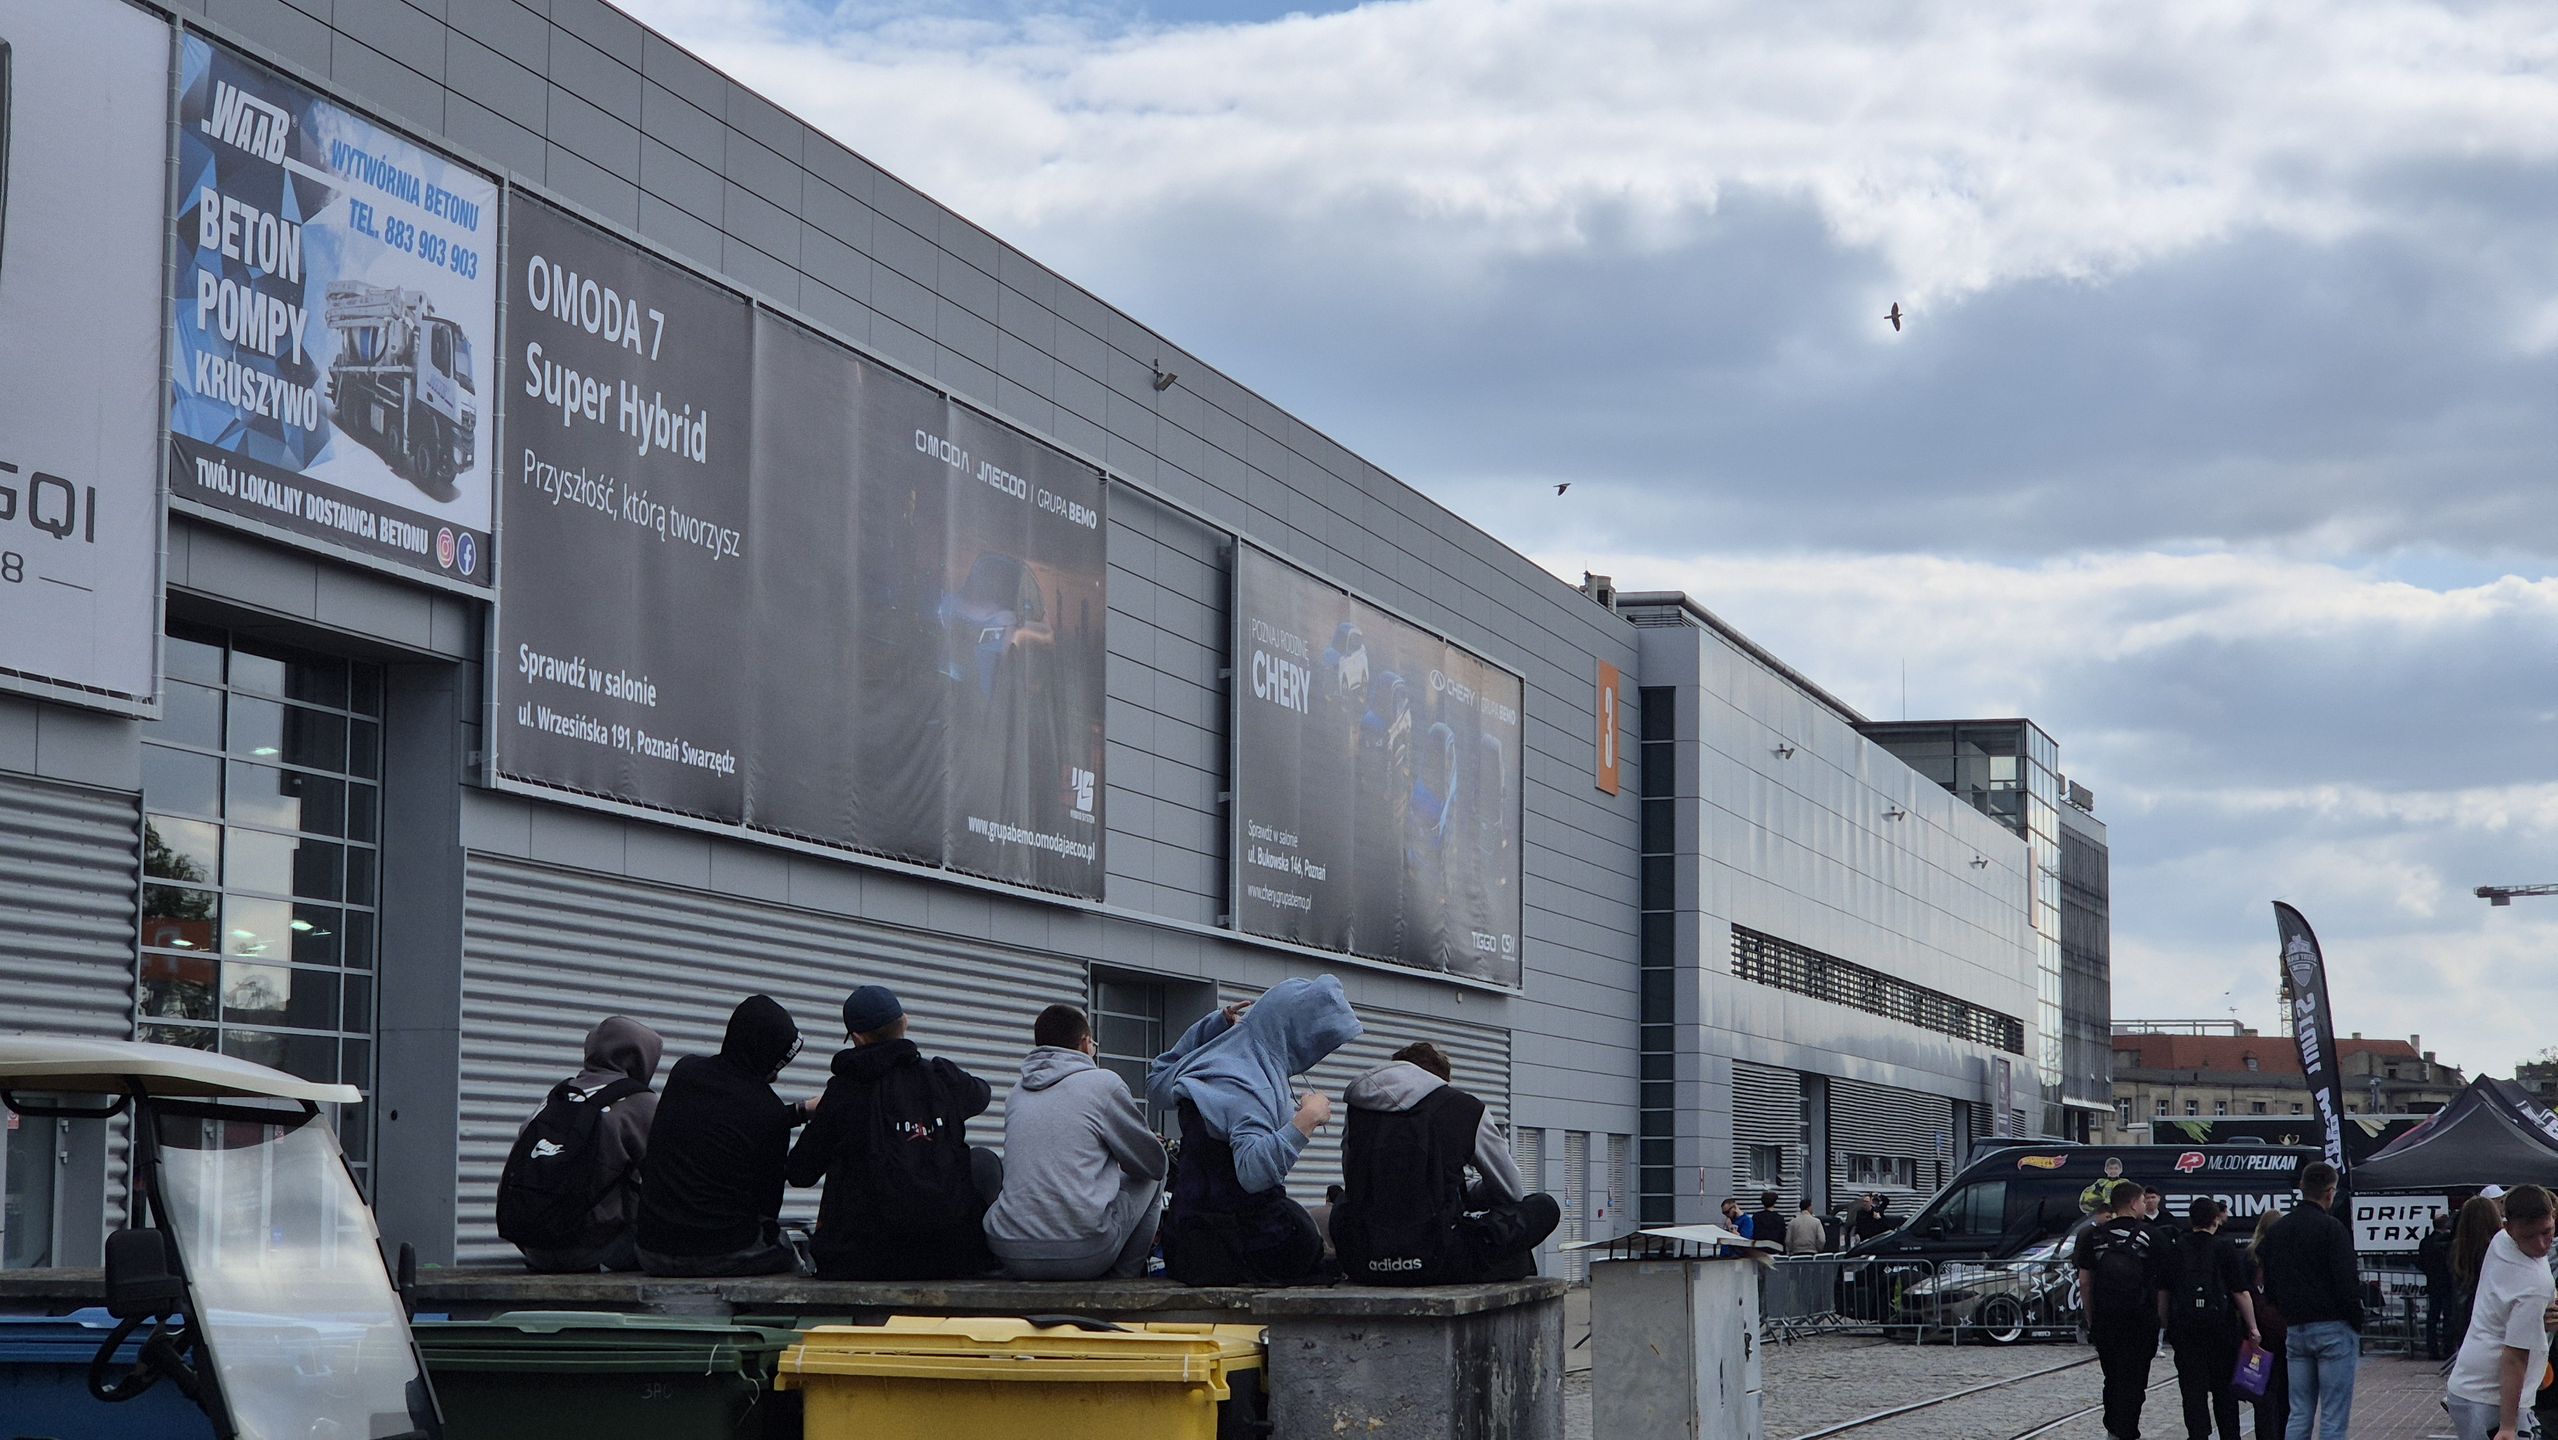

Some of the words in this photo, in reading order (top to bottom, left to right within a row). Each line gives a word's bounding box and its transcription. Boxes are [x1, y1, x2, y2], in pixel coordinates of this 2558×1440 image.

[207, 80, 290, 166] WAAB
[331, 138, 421, 207] WYTWÓRNIA
[424, 182, 480, 232] BETONU
[199, 185, 301, 284] BETON
[350, 198, 379, 239] TEL.
[384, 215, 415, 253] 883
[418, 229, 447, 267] 903
[450, 248, 478, 281] 903
[197, 268, 308, 366] POMPY
[528, 255, 643, 355] OMODA
[649, 308, 665, 361] 7
[195, 350, 319, 432] KRUSZYWO
[526, 342, 612, 427] Super
[619, 380, 707, 464] Hybrid
[195, 457, 236, 496] TWÓJ
[240, 471, 303, 517] LOKALNY
[306, 494, 377, 540] DOSTAWCA
[379, 517, 429, 555] BETONU
[524, 448, 618, 521] Przyszłość,
[623, 483, 666, 542] którą
[670, 505, 741, 561] tworzysz
[915, 429, 970, 474] OMODA
[976, 461, 1027, 501] JAECOO
[1037, 488, 1068, 518] GRUPA
[1068, 504, 1098, 530] BEMO
[519, 642, 586, 689] Sprawdź
[588, 668, 603, 693] w
[604, 670, 657, 707] salonie
[1252, 650, 1311, 715] CHERY
[518, 701, 535, 728] ul.
[537, 705, 608, 746] Wrzesińska
[611, 723, 635, 755] 191,
[637, 730, 679, 762] Poznań
[681, 741, 736, 778] Swarzędz
[1605, 686, 1613, 769] 3
[968, 815, 1096, 866] www.grupabemo.omodajaecoo.pl
[1247, 844, 1257, 864] ul.
[1257, 846, 1289, 872] Bukowska
[1304, 858, 1327, 881] Poznań
[1248, 818, 1273, 842] Sprawdź
[1273, 830, 1280, 843] w
[1279, 828, 1298, 848] salonie
[2356, 1205, 2442, 1221] DRIFT
[1368, 1256, 1423, 1272] adidas
